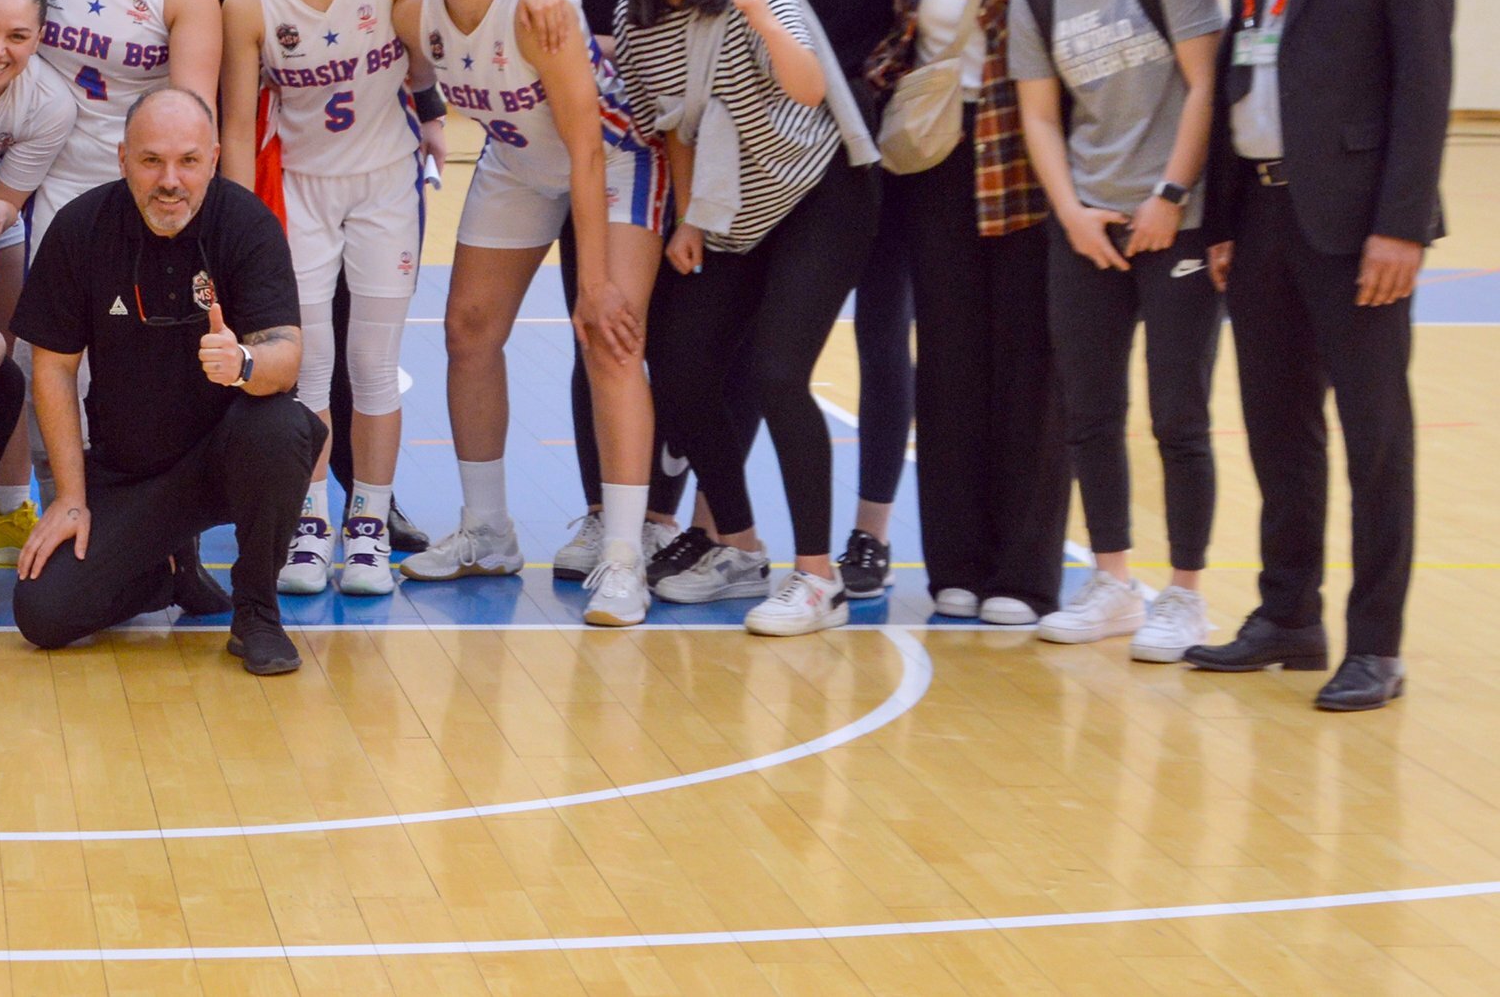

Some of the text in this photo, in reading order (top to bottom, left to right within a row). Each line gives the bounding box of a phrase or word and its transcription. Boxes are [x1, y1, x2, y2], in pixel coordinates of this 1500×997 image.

[42, 20, 112, 60] RSİN
[75, 65, 109, 101] 4
[325, 90, 356, 133] 5
